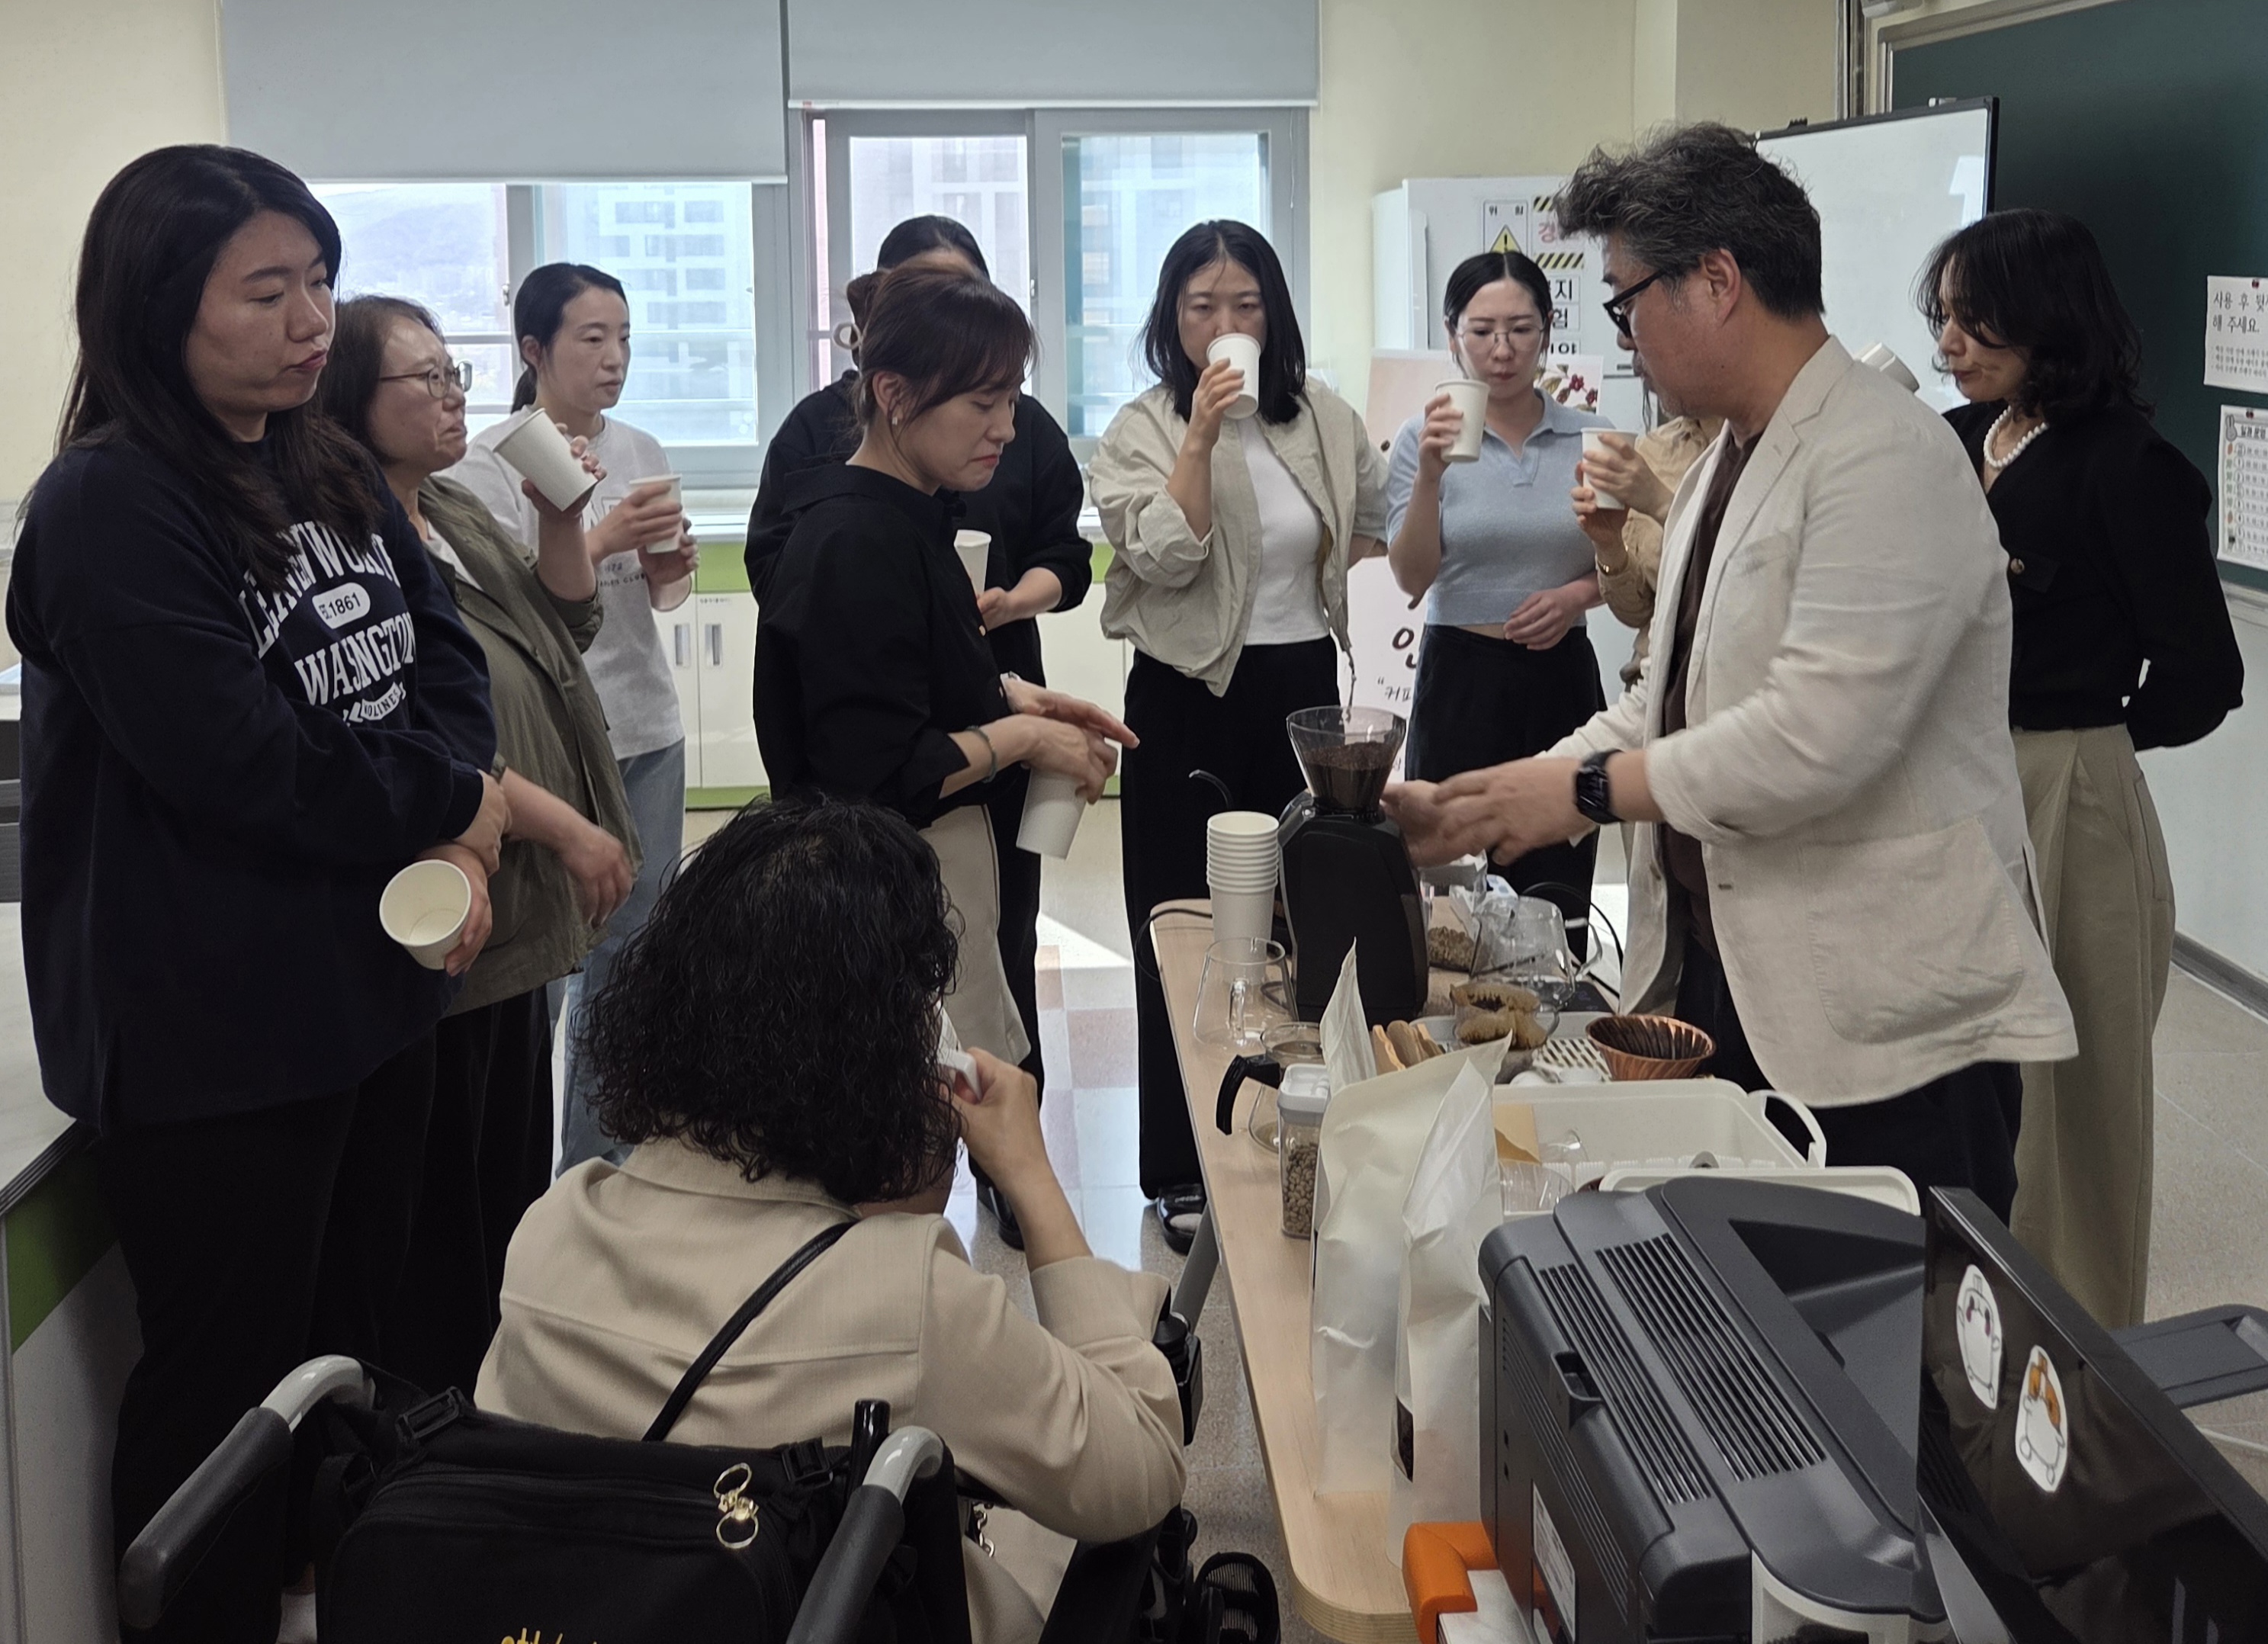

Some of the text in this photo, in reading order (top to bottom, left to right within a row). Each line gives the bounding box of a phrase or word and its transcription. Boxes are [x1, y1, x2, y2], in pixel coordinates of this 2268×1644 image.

[1548, 278, 1573, 300] 지
[2214, 291, 2233, 310] 사용
[2238, 293, 2249, 311] 후
[2212, 314, 2260, 333] 해 주세요.
[329, 592, 361, 617] 1861
